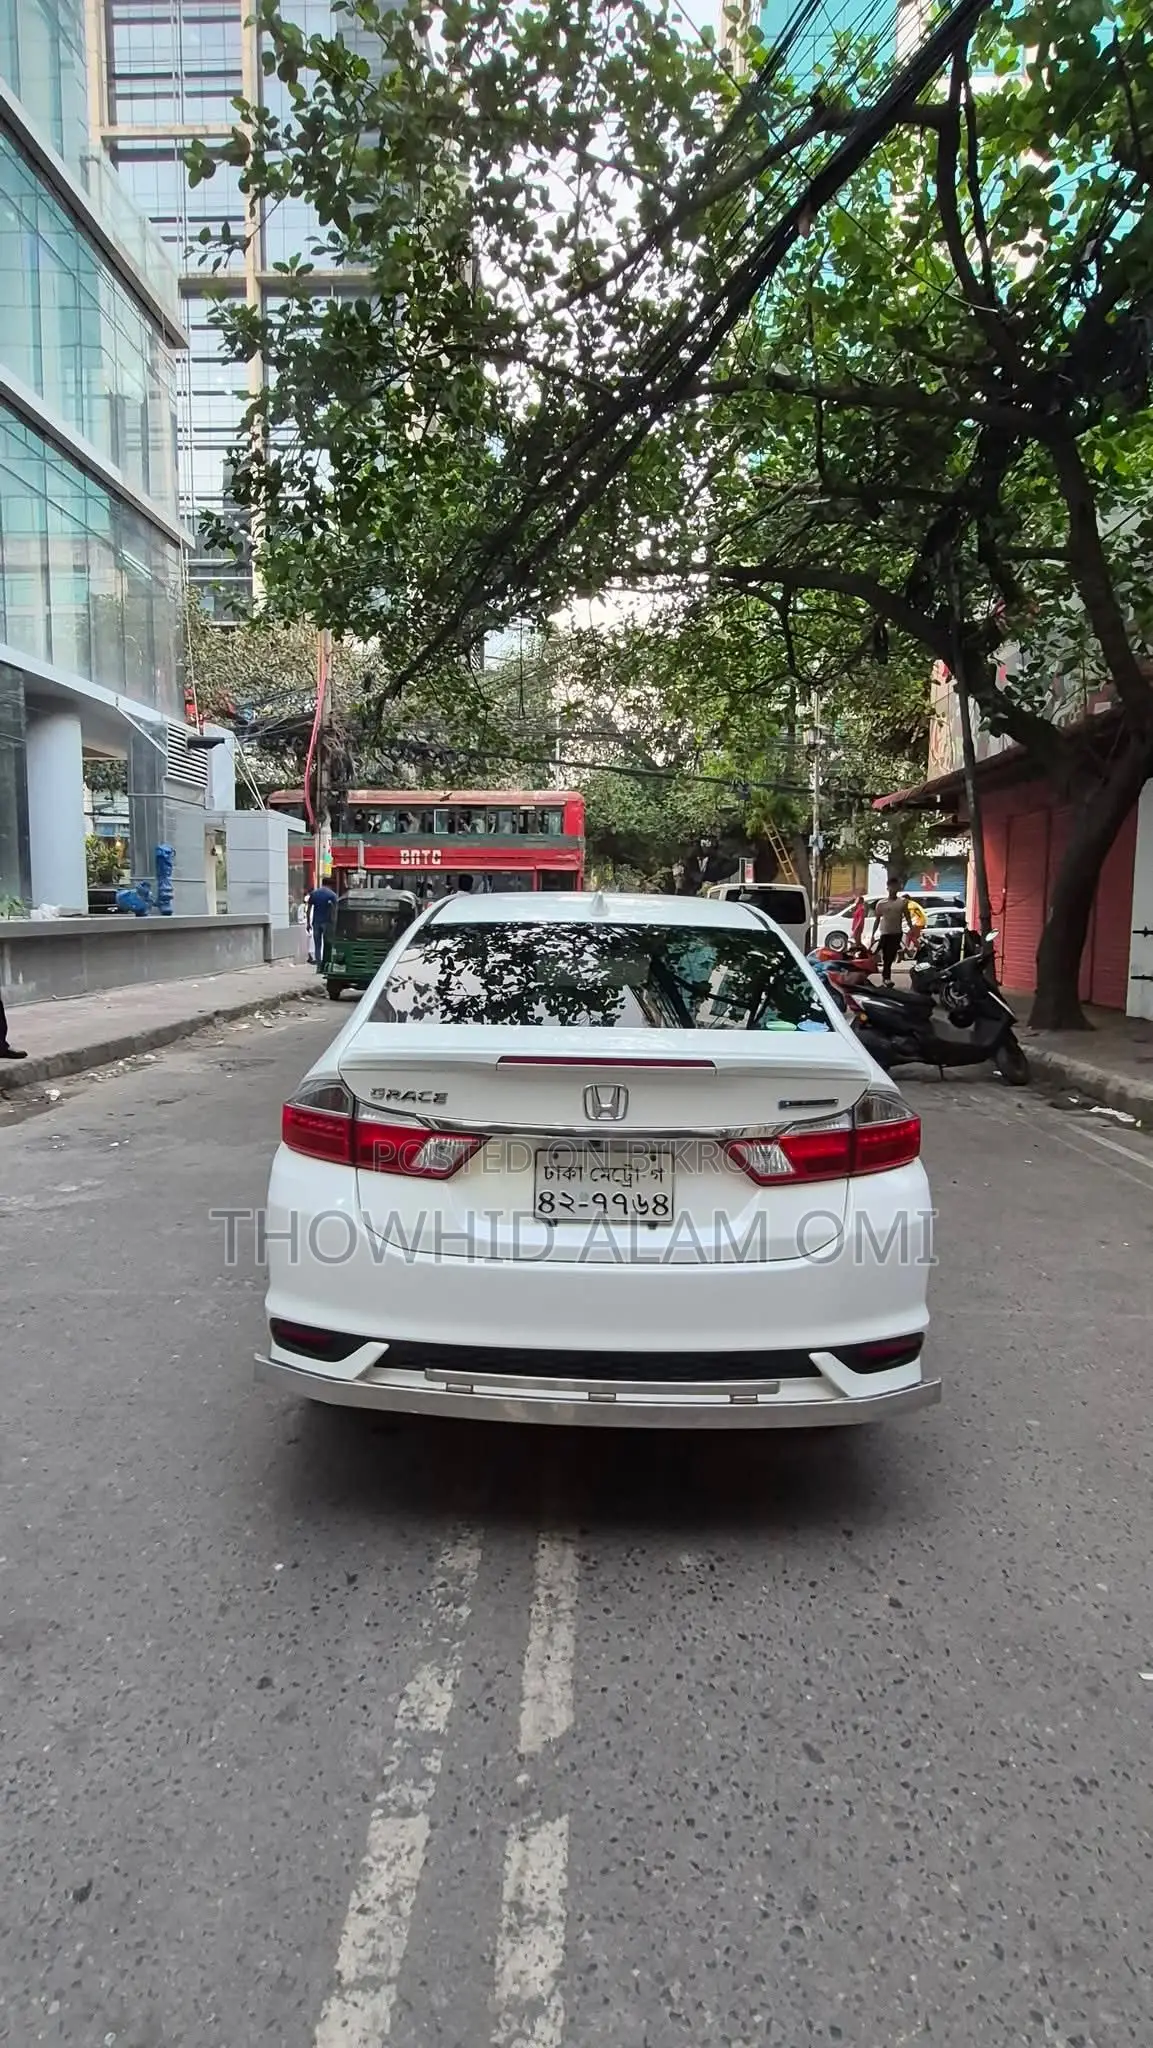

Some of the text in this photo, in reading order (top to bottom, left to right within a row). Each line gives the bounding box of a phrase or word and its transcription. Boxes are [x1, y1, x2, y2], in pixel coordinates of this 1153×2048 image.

[370, 1087, 448, 1105] GRACE
[543, 1165, 583, 1183] ঢাকা
[538, 1191, 669, 1216] ৪২-৭৭৬৪
